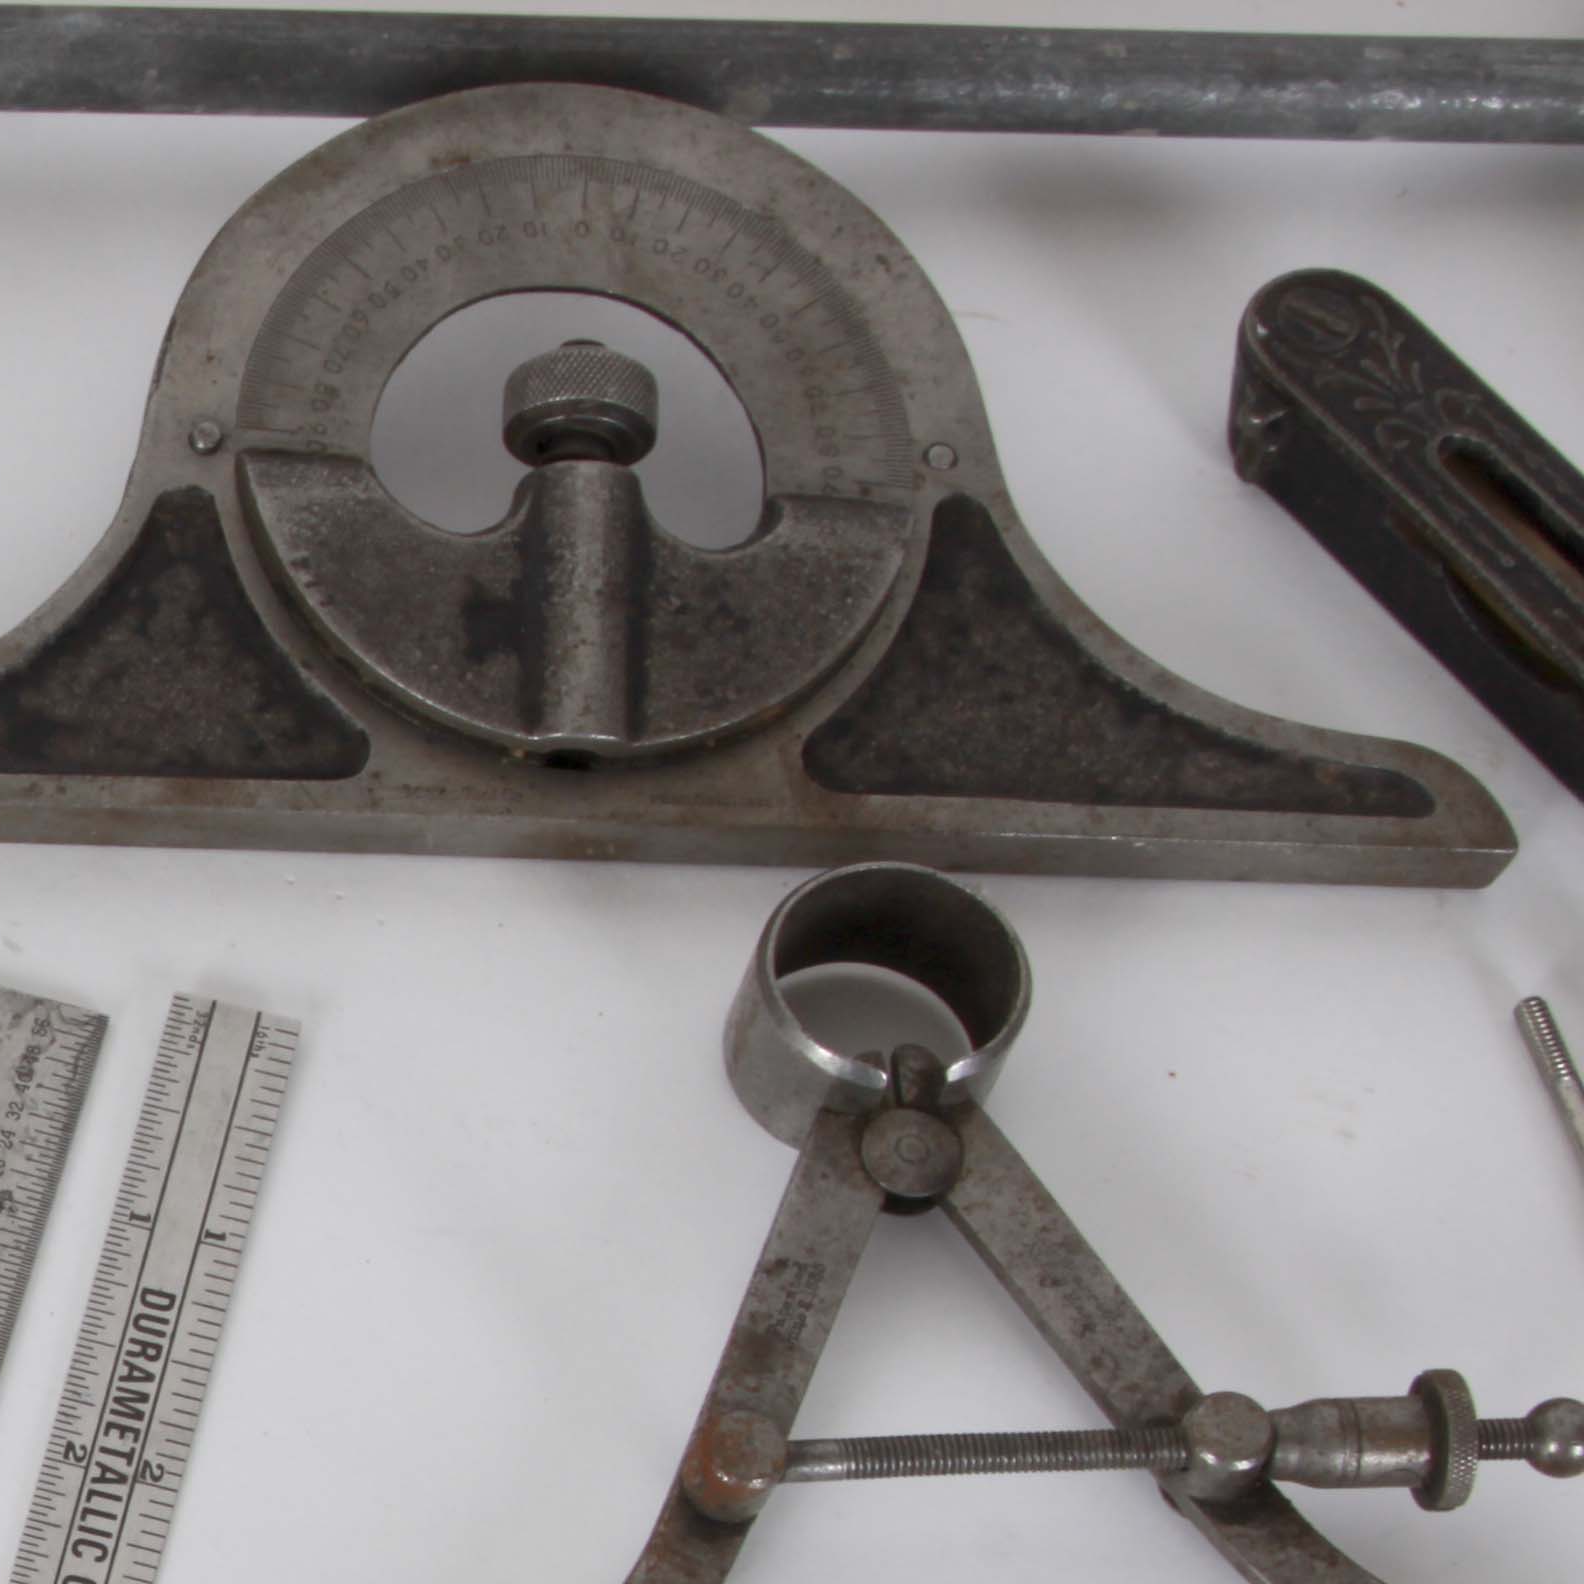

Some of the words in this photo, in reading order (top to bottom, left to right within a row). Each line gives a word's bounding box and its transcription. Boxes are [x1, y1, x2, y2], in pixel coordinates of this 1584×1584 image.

[128, 1211, 151, 1223] 1
[204, 1229, 226, 1241] 1
[64, 1287, 177, 1563] DURAMETALLIC
[63, 1440, 88, 1463] 2
[137, 1459, 164, 1483] 2
